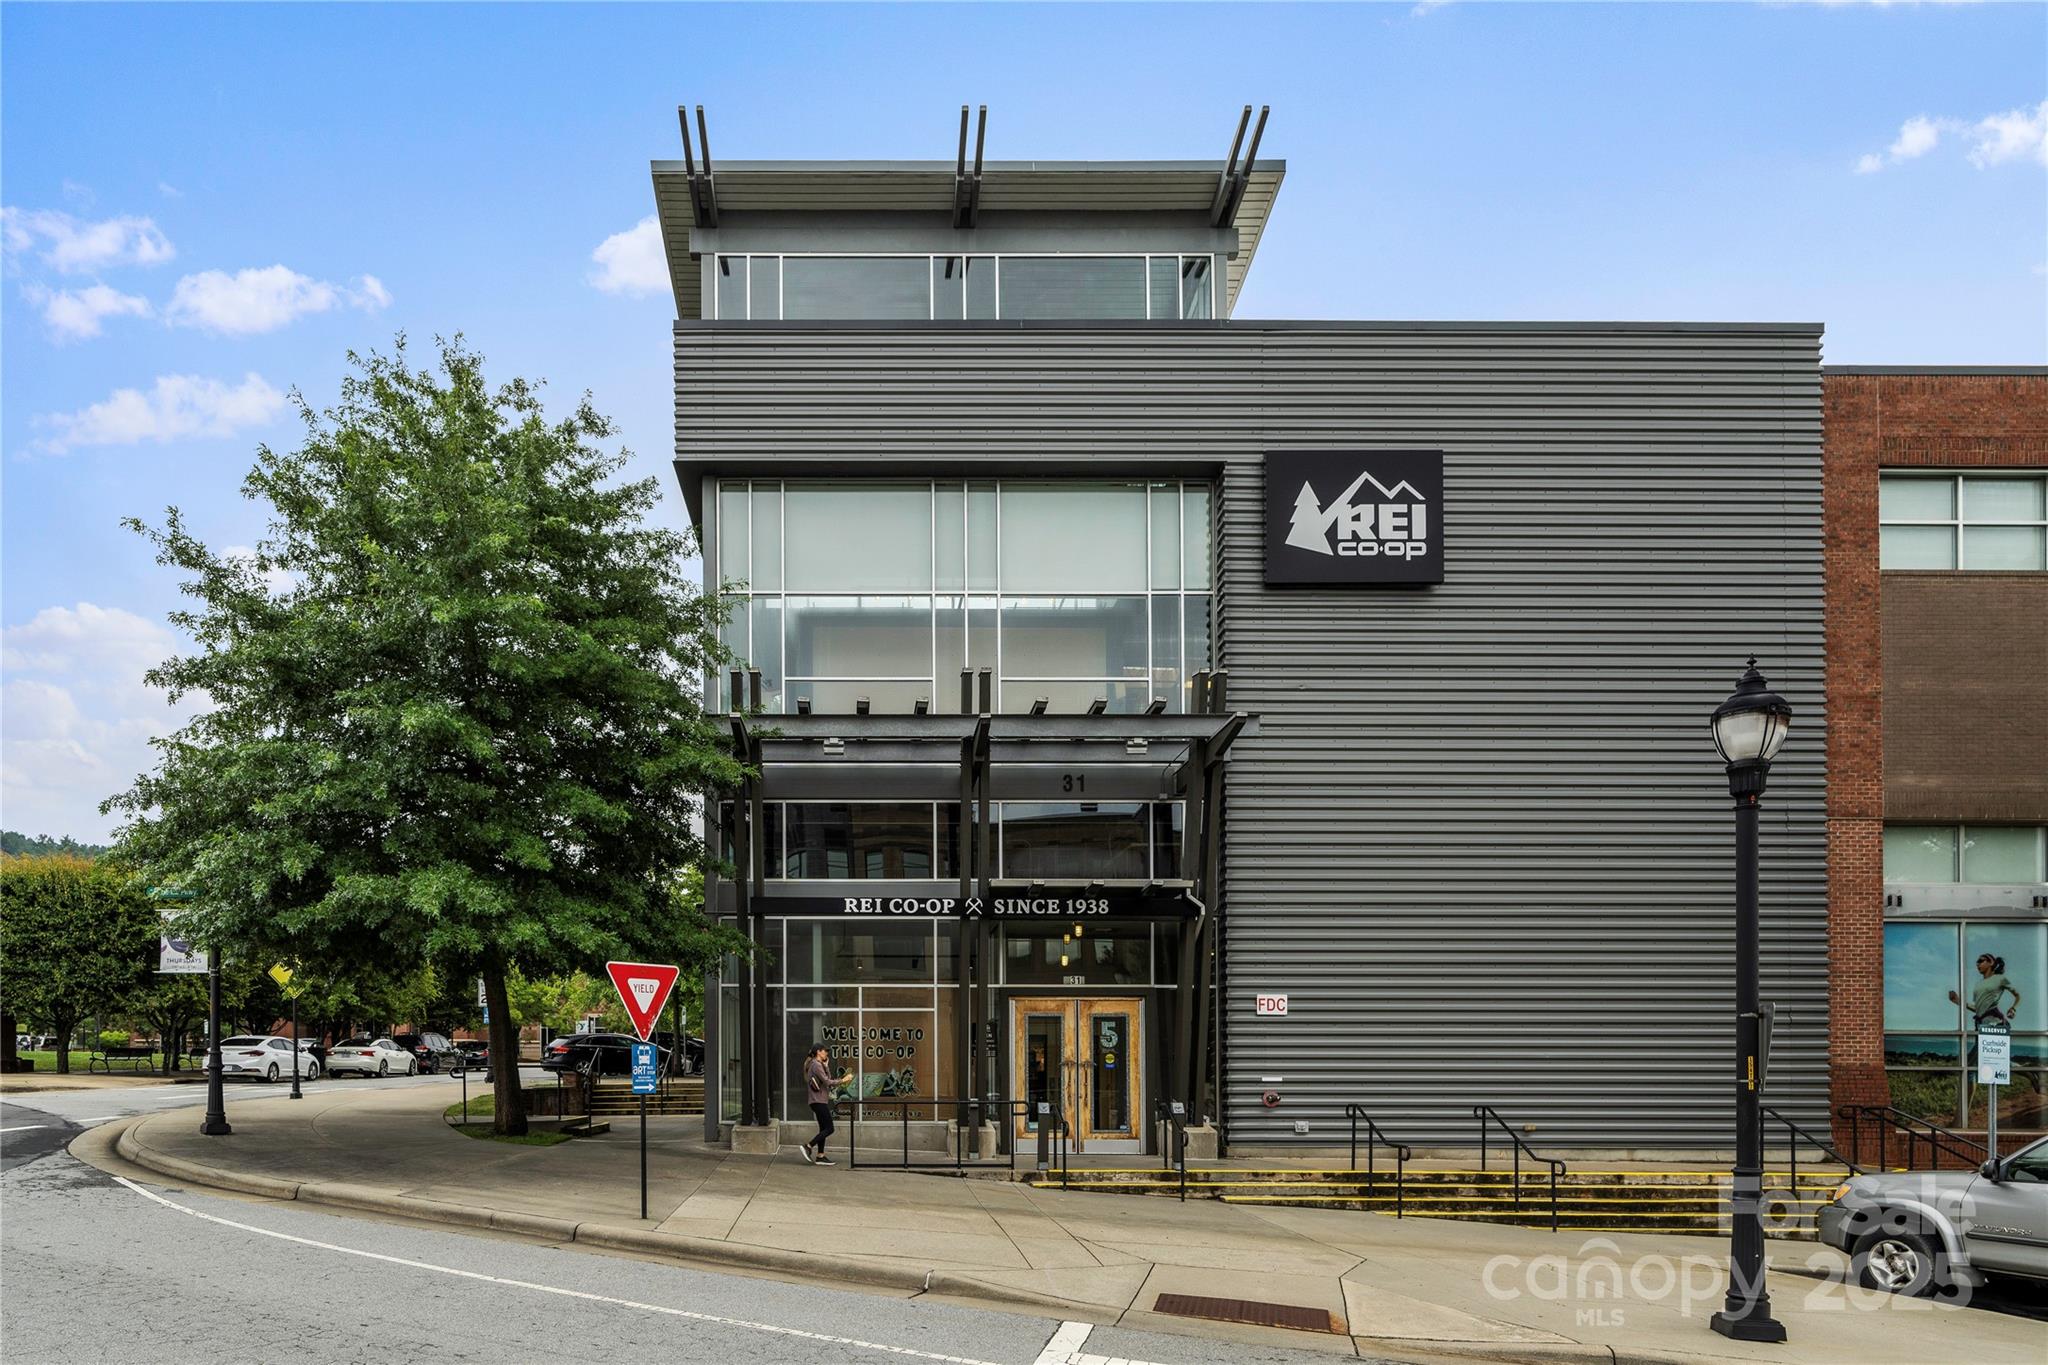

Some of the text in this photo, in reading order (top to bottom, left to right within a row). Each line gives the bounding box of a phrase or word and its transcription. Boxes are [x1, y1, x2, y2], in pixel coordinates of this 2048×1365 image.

[1337, 503, 1427, 540] REI
[1063, 774, 1085, 792] 31
[844, 898, 1109, 914] REI CO-OP SINCE 1938
[633, 983, 655, 993] YIELD
[1258, 997, 1286, 1012] FDC
[822, 1025, 924, 1041] WELCOME TO
[831, 1045, 915, 1059] THE CO-OP
[1982, 1046, 2002, 1055] Pickup
